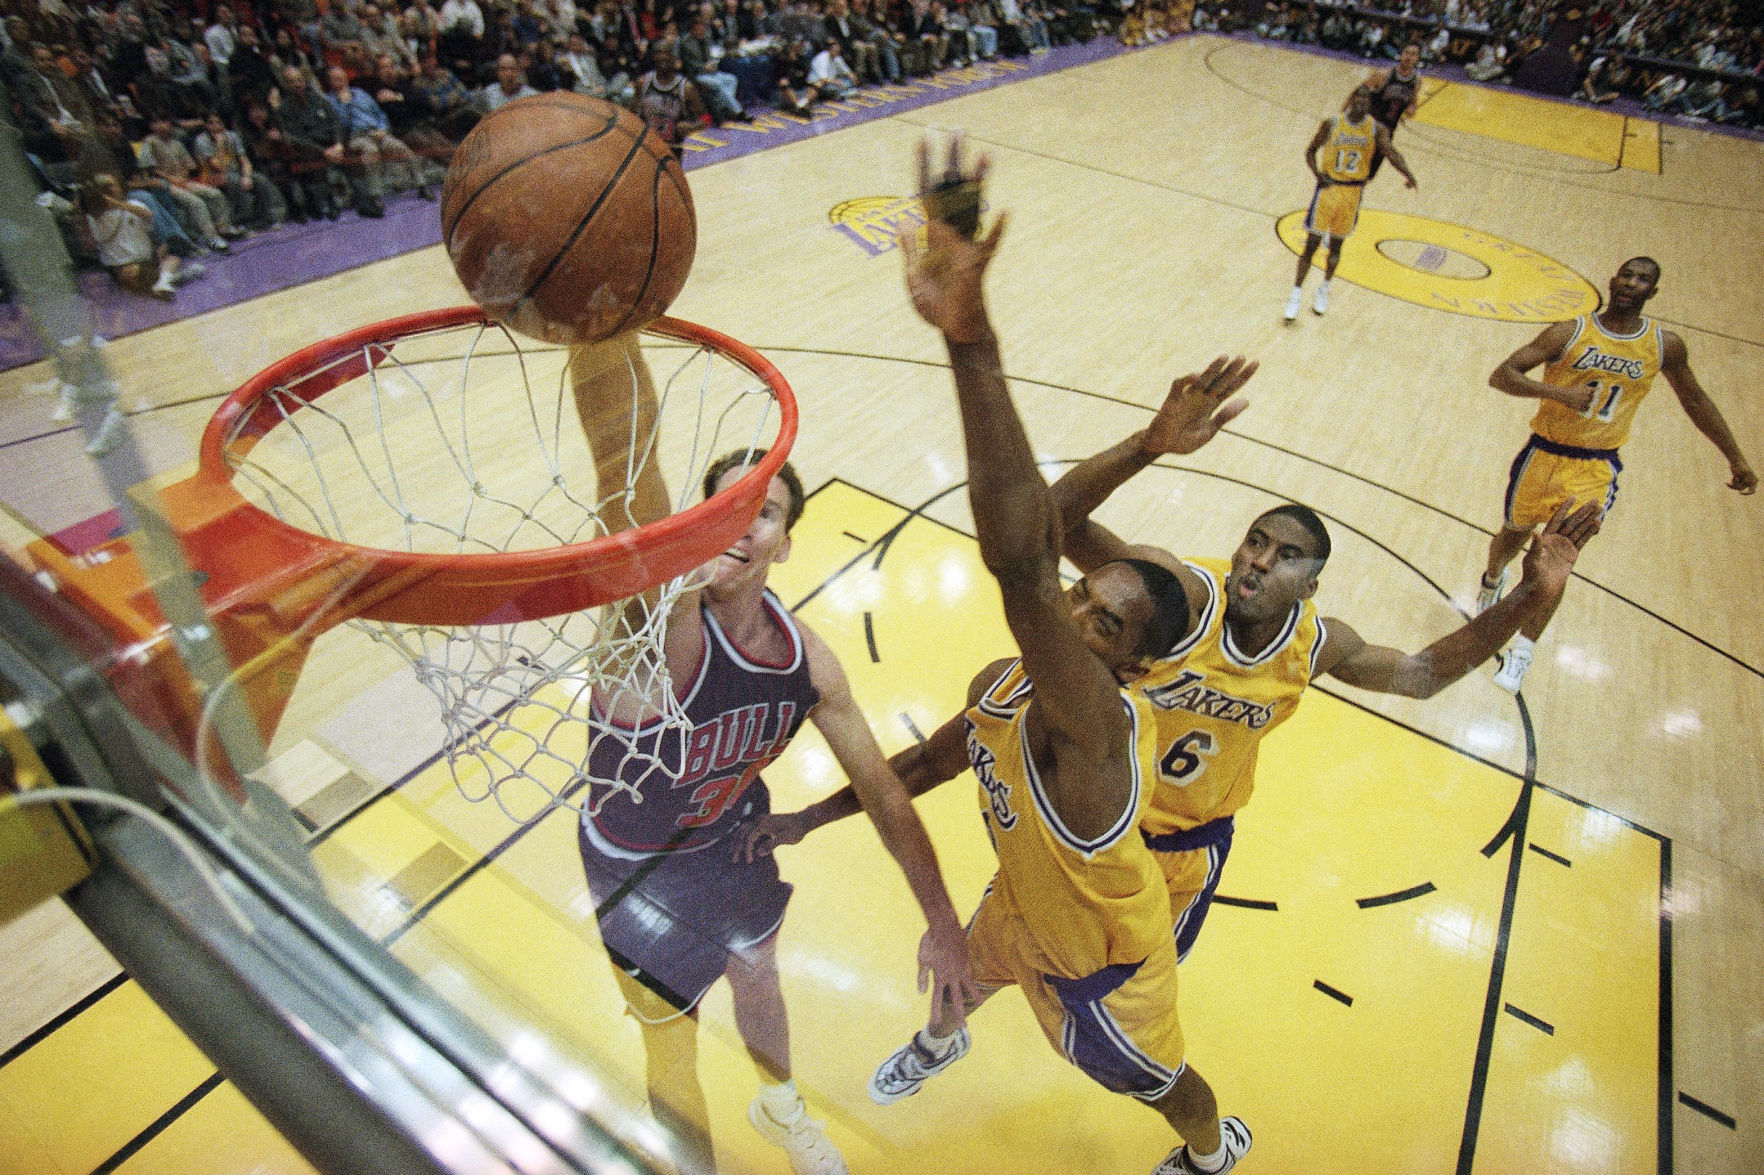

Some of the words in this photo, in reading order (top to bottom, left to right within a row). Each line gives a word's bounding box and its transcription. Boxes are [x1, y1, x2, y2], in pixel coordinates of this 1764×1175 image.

[1334, 149, 1363, 173] 12
[1571, 346, 1645, 379] LAKERS
[1142, 670, 1277, 731] LAKERS
[1158, 729, 1219, 787] 6
